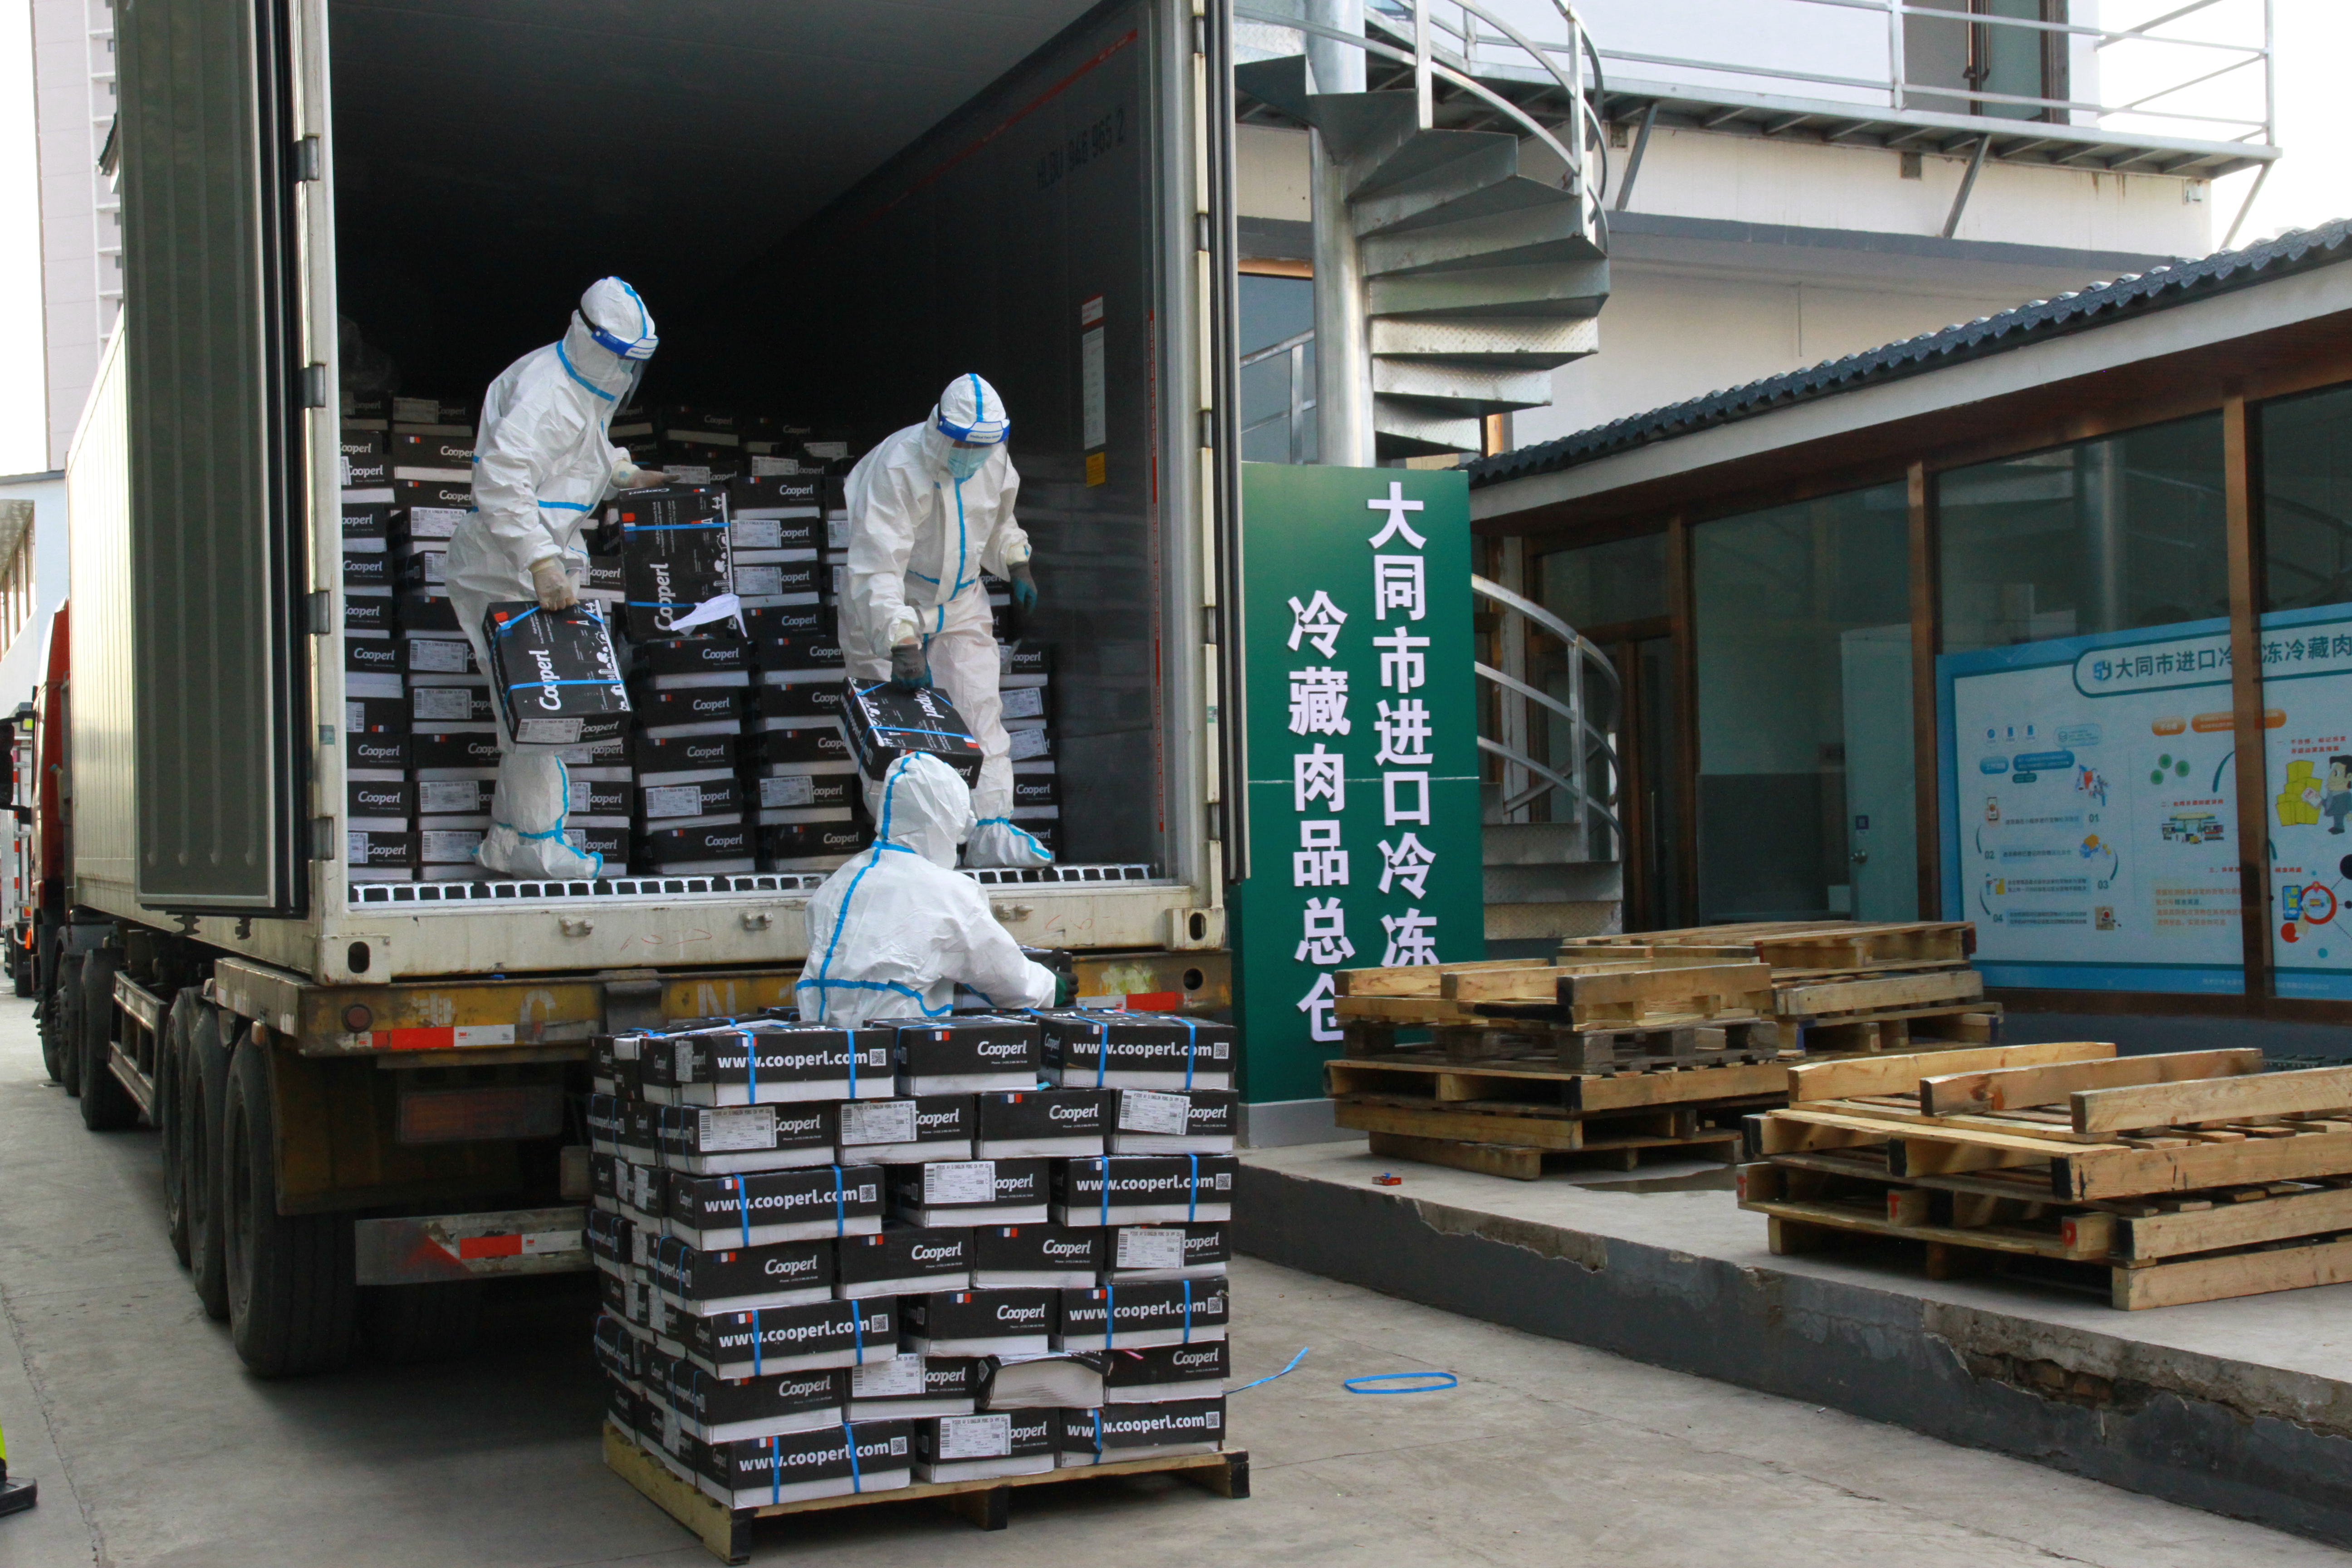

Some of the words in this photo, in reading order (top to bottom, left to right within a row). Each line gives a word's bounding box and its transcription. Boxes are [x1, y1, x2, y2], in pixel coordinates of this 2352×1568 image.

[354, 399, 381, 410] ooperl
[439, 405, 466, 416] ooperl
[340, 442, 371, 453] ooperl
[440, 446, 474, 459] Cooper
[351, 465, 383, 478] ooperl
[710, 470, 737, 481] ooperl
[798, 466, 824, 475] ooperl
[439, 490, 471, 503] Coope
[779, 484, 813, 497] Cooperl
[342, 514, 373, 526] ooperl
[781, 526, 809, 539] ooperl
[343, 559, 382, 573] Cooperl
[590, 568, 621, 578] ooperl
[782, 570, 810, 583] ooperl
[980, 573, 1001, 585] operl
[649, 563, 676, 631] Cooperl
[346, 606, 380, 617] ooperl
[781, 614, 816, 627] Cooperl
[353, 647, 395, 662] Cooperl
[702, 647, 739, 661] Cooperl
[810, 647, 841, 658] Cooper
[1014, 651, 1041, 664] ooperl
[528, 649, 561, 710] Cooperl
[693, 697, 730, 711] Cooperl
[812, 692, 838, 705] Coope
[914, 687, 945, 719] ooperl
[472, 701, 491, 711] oope
[582, 721, 618, 733] ooperl
[1367, 482, 1439, 967] 大同市进口冷冻
[468, 743, 498, 755] Coope
[593, 744, 623, 755] ooperl
[818, 738, 846, 749] Coope
[358, 745, 400, 759] Cooperl
[686, 745, 724, 759] Cooperl
[701, 789, 730, 803] ooperl
[813, 785, 843, 796] ooperl
[1015, 784, 1050, 796] Cooperl
[358, 791, 401, 805] Cooperl
[590, 793, 622, 806] ooperl
[1287, 590, 1356, 1041] 冷藏肉品总仓
[2089, 813, 2099, 823] 01
[705, 833, 743, 848] Cooperl
[823, 832, 859, 845] Cooperl
[1027, 829, 1051, 839] operl
[585, 839, 617, 852] ooperl
[1985, 850, 1995, 859] 02
[2097, 880, 2109, 889] 03
[1993, 914, 2003, 922] 04
[977, 1040, 1027, 1058] Cooperl
[1044, 1033, 1061, 1051] Cooperl
[1073, 1042, 1212, 1058] www.cooperl.com
[654, 1054, 666, 1072] Cooperl
[692, 1051, 706, 1068] ooperl
[718, 1050, 867, 1068] www.cooperl.com
[1049, 1103, 1098, 1122] Cooperl
[995, 1174, 1033, 1192] ooperl
[1076, 1175, 1214, 1192] www.cooperl.com
[705, 1188, 857, 1212] www.cooperl.com
[1043, 1239, 1091, 1257] Cooperl
[1185, 1232, 1219, 1251] ooperl
[911, 1241, 962, 1261] Cooperl
[764, 1254, 817, 1275] Cooperl
[997, 1303, 1045, 1322] Cooperl
[1069, 1301, 1206, 1321] wwwcooperl.com
[695, 1323, 710, 1343] Cooperl
[719, 1319, 870, 1348] www.cooperl.com
[1172, 1348, 1219, 1367] Cooperl
[779, 1376, 831, 1397] Cooperl
[1011, 1421, 1047, 1441] ooperl
[740, 1441, 888, 1472] www.cooperlcom
